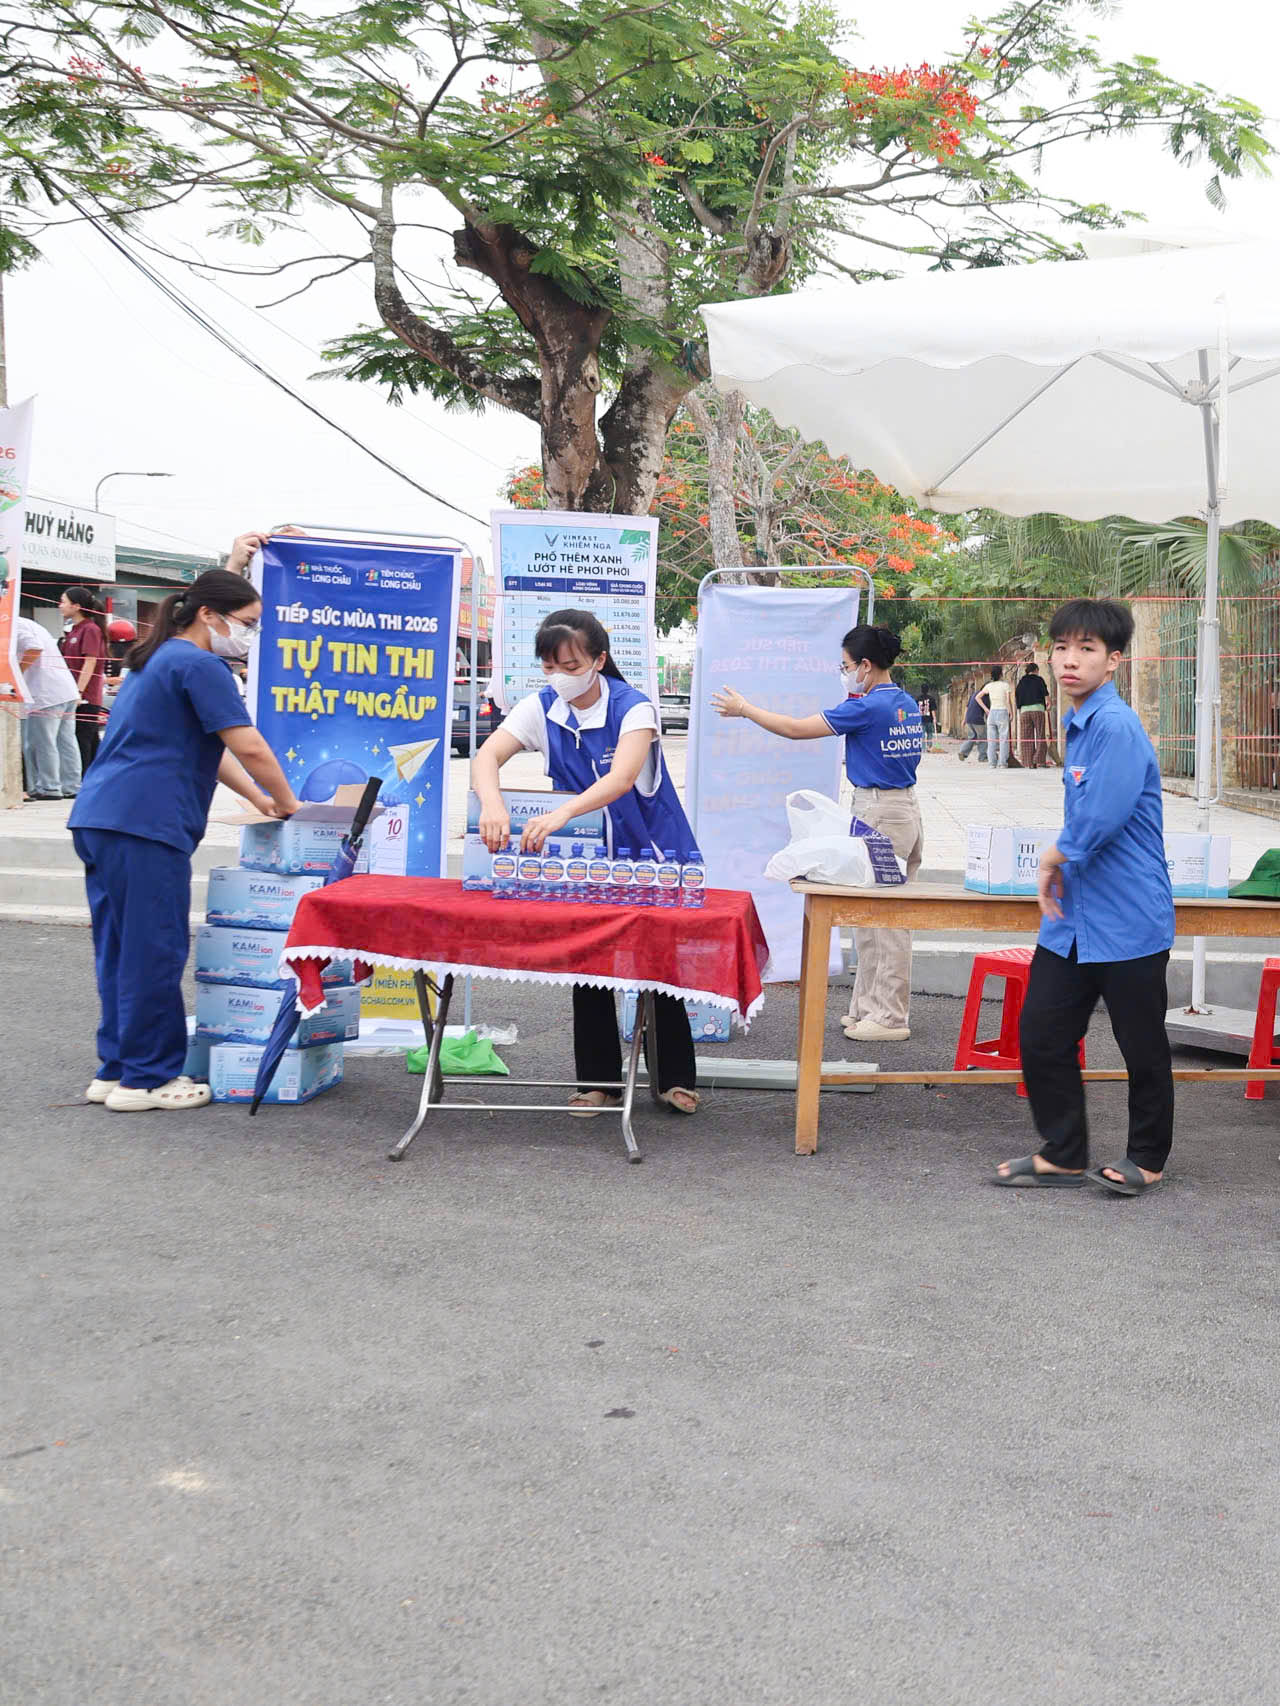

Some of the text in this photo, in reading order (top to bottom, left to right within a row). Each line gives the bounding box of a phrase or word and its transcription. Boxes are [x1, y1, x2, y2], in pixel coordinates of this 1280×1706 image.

[593, 554, 622, 564] XANH
[312, 575, 331, 584] LONG
[380, 580, 400, 589] LONG
[275, 602, 438, 632] TIẾP SỨC MÙA THI 2026
[277, 635, 435, 680] TỰ TIN THI
[271, 682, 340, 720] THẬT
[889, 724, 906, 736] NHÀ
[880, 738, 922, 751] LONG CH
[387, 818, 402, 835] 10
[1017, 854, 1039, 868] tru
[1018, 870, 1038, 878] WAT
